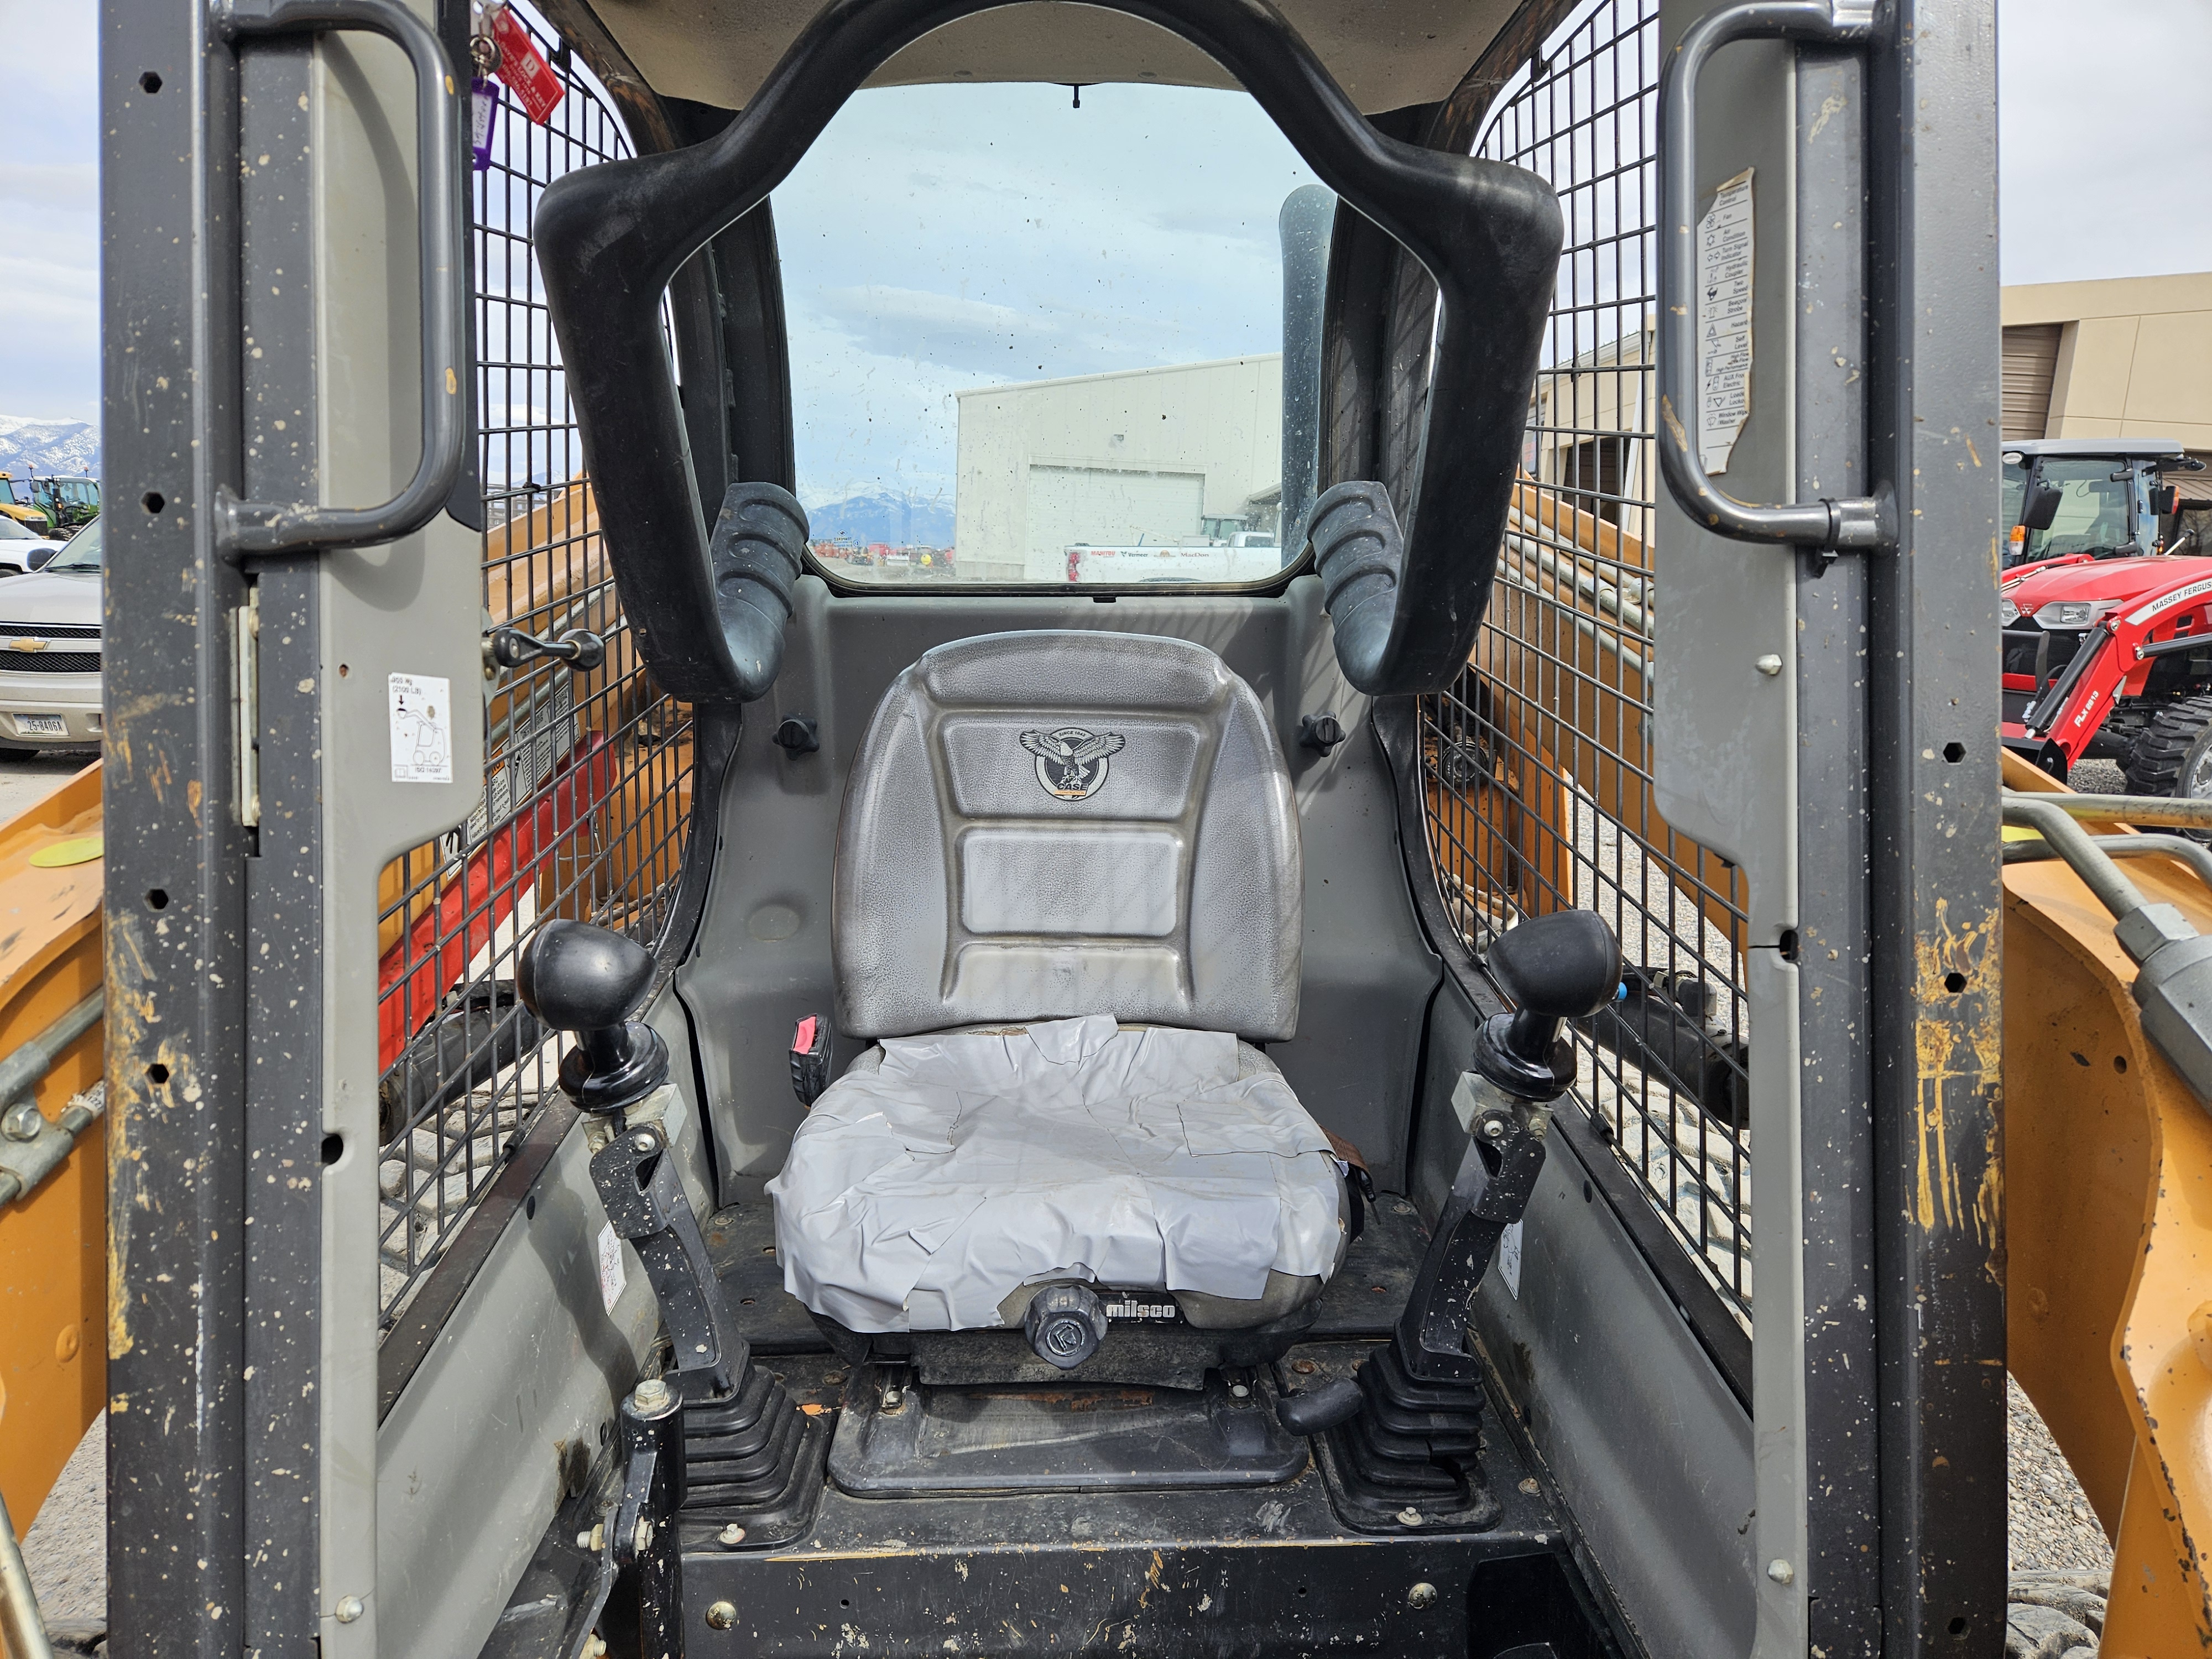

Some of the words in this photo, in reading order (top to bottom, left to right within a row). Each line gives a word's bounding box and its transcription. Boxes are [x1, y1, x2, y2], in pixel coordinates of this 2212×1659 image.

[518, 66, 531, 87] LOCK
[535, 92, 546, 107] KEY
[1719, 195, 1736, 206] Control
[1723, 231, 1745, 242] Condition
[1734, 241, 1749, 250] Signal
[1721, 251, 1741, 260] Indicator
[1725, 261, 1748, 271] Hydraulic
[1725, 269, 1744, 278] Coupler
[1733, 285, 1748, 294] Speed
[1728, 305, 1743, 314] Strobe
[1734, 341, 1747, 349] Level
[2152, 591, 2182, 612] MASSEY
[2184, 581, 2212, 597] FERGUS
[28, 721, 62, 732] 25-8406A
[1106, 1300, 1175, 1318] milsco
